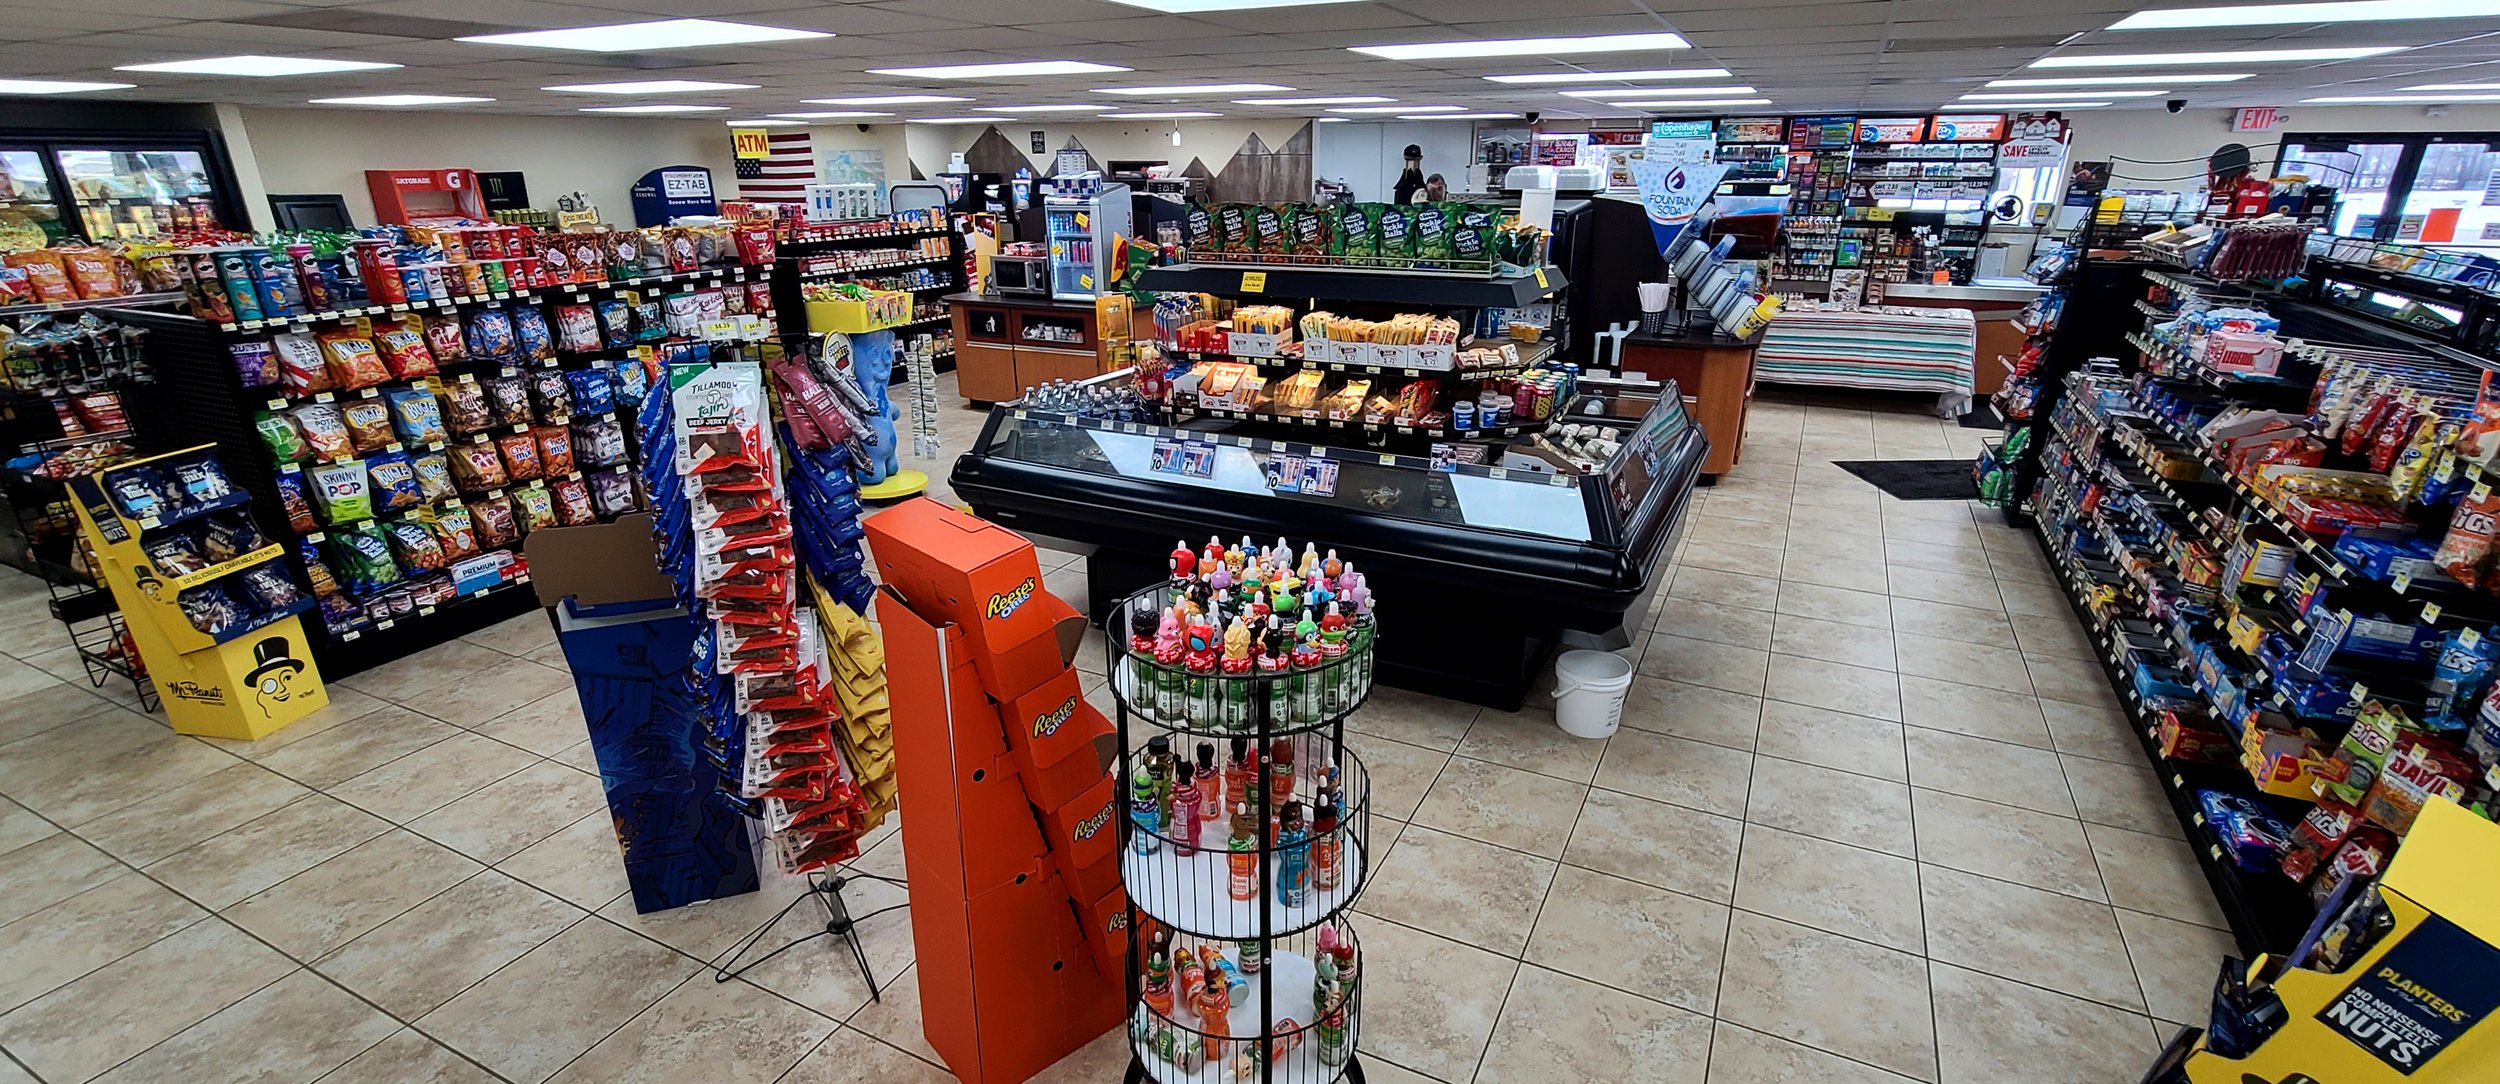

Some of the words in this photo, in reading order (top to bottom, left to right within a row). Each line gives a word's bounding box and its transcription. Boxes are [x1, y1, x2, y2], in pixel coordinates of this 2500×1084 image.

[2241, 108, 2275, 129] EXIT
[1661, 122, 1707, 136] Copenhagen
[737, 134, 768, 152] ATM
[2003, 145, 2029, 157] SAVE
[447, 172, 462, 189] G
[668, 179, 706, 190] EZ-TAB
[1650, 194, 1694, 206] FOUNTAIN
[1657, 205, 1682, 215] SODA
[1189, 219, 1208, 230] Pickle
[1258, 219, 1278, 231] Pickle
[1383, 221, 1404, 232] Pickle
[1419, 219, 1441, 230] Pickle
[1422, 225, 1440, 236] Balls
[1261, 226, 1278, 237] Balls
[1455, 238, 1479, 249] Pickle
[1459, 244, 1480, 253] Balls
[28, 262, 55, 275] Sun
[75, 260, 104, 273] Sun
[673, 366, 689, 376] NEW
[510, 442, 532, 455] Chex
[550, 443, 568, 455] mix
[515, 450, 533, 461] mix
[2283, 457, 2301, 466] BIG
[1151, 458, 1162, 470] 10
[1431, 460, 1440, 470] 6
[1266, 476, 1278, 488] 10
[329, 482, 362, 498] POP
[102, 526, 127, 544] NUTS
[462, 560, 496, 576] PREMIUM
[986, 577, 1035, 620] Reese's
[1001, 592, 1031, 619] OREO
[1032, 695, 1077, 739] Reese's
[2349, 719, 2390, 755] BiGS
[1073, 800, 1114, 842] Reese's
[2305, 805, 2342, 839] BiGS
[2377, 967, 2466, 1023] PLANTERS
[2344, 993, 2434, 1049] COMPLETELY
[2351, 986, 2374, 1002] NO
[2372, 998, 2443, 1045] NONSENSE
[2326, 1001, 2421, 1068] NUTS.
